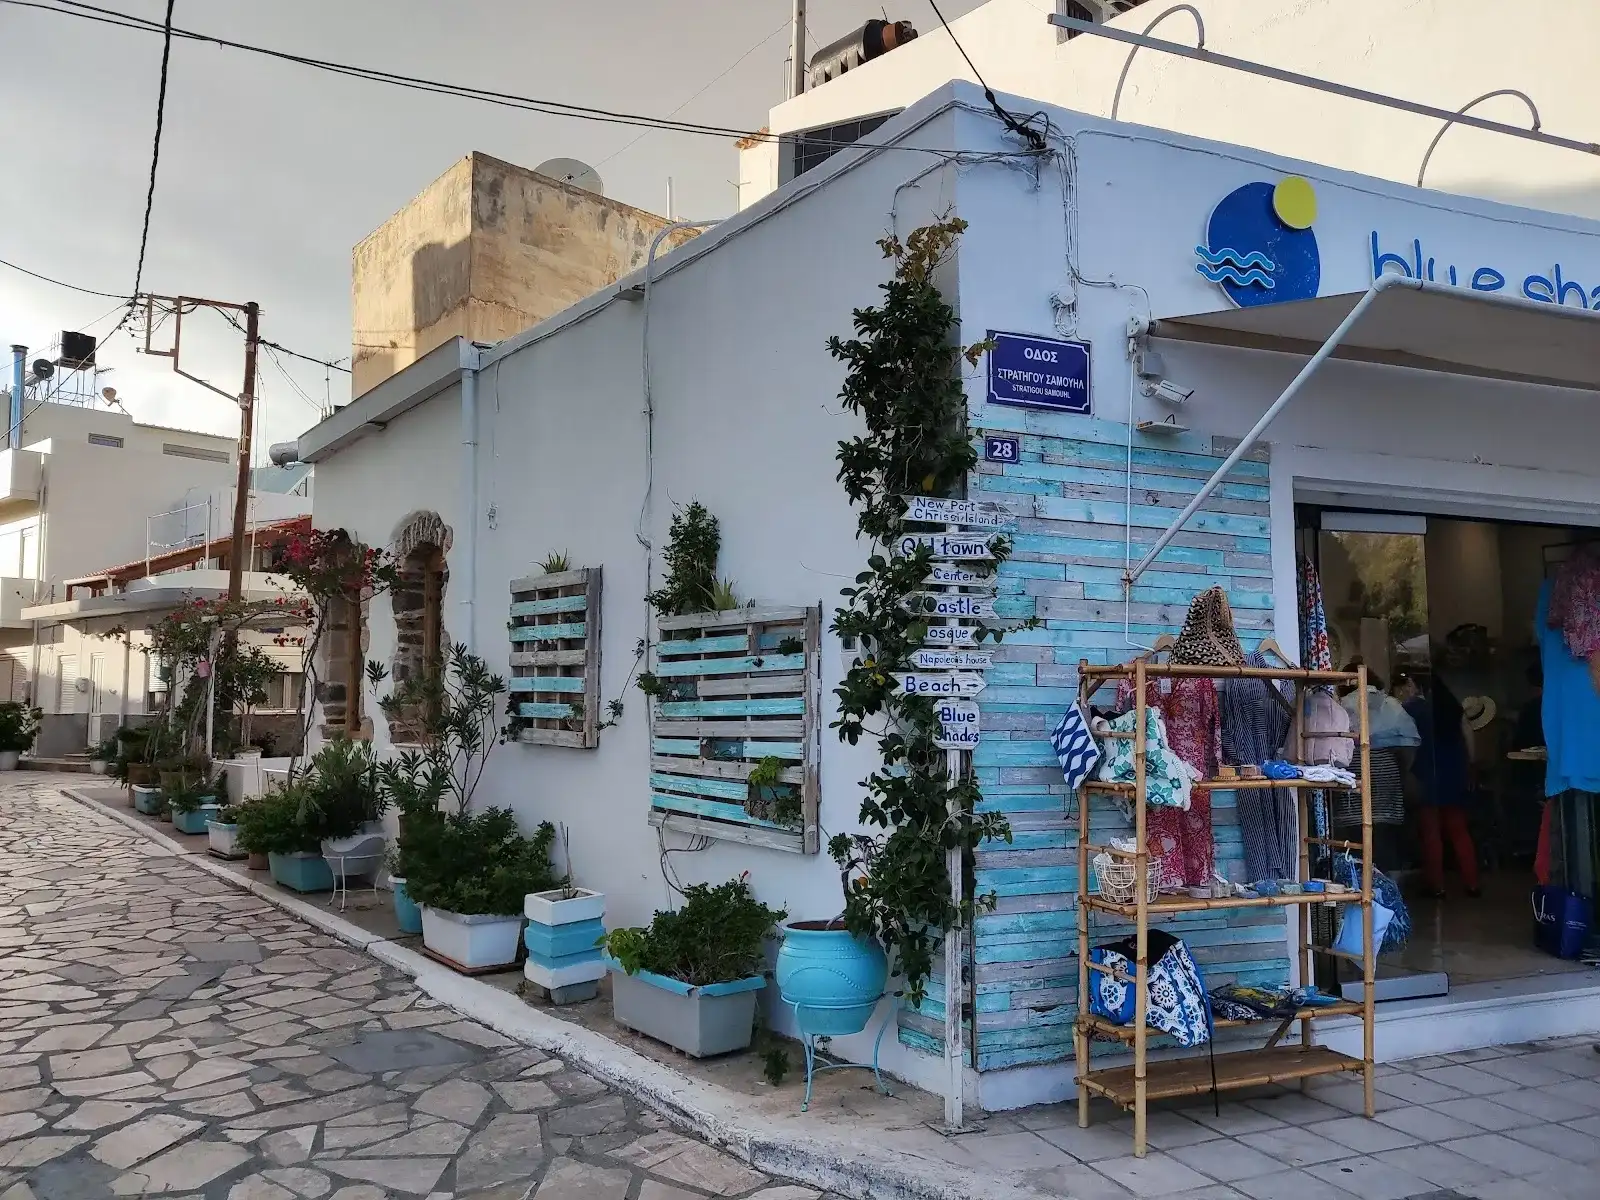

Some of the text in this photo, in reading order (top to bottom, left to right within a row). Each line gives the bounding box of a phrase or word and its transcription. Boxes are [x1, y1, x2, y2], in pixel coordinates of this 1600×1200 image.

[1024, 347, 1058, 363] ΟΔΟΣ
[997, 368, 1085, 390] ΣΤΡΑΤΗΓΟΥ ΣΑΜΟΥΗΛ
[1012, 384, 1071, 399] STRATIGOU SAMOUHL
[992, 442, 1012, 458] 28
[916, 497, 976, 512] New Port
[940, 537, 984, 555] town
[933, 567, 974, 581] Center
[937, 598, 981, 614] astle
[925, 628, 969, 643] osque
[965, 654, 987, 665] house
[905, 676, 961, 693] Beach
[941, 706, 976, 722] Blue
